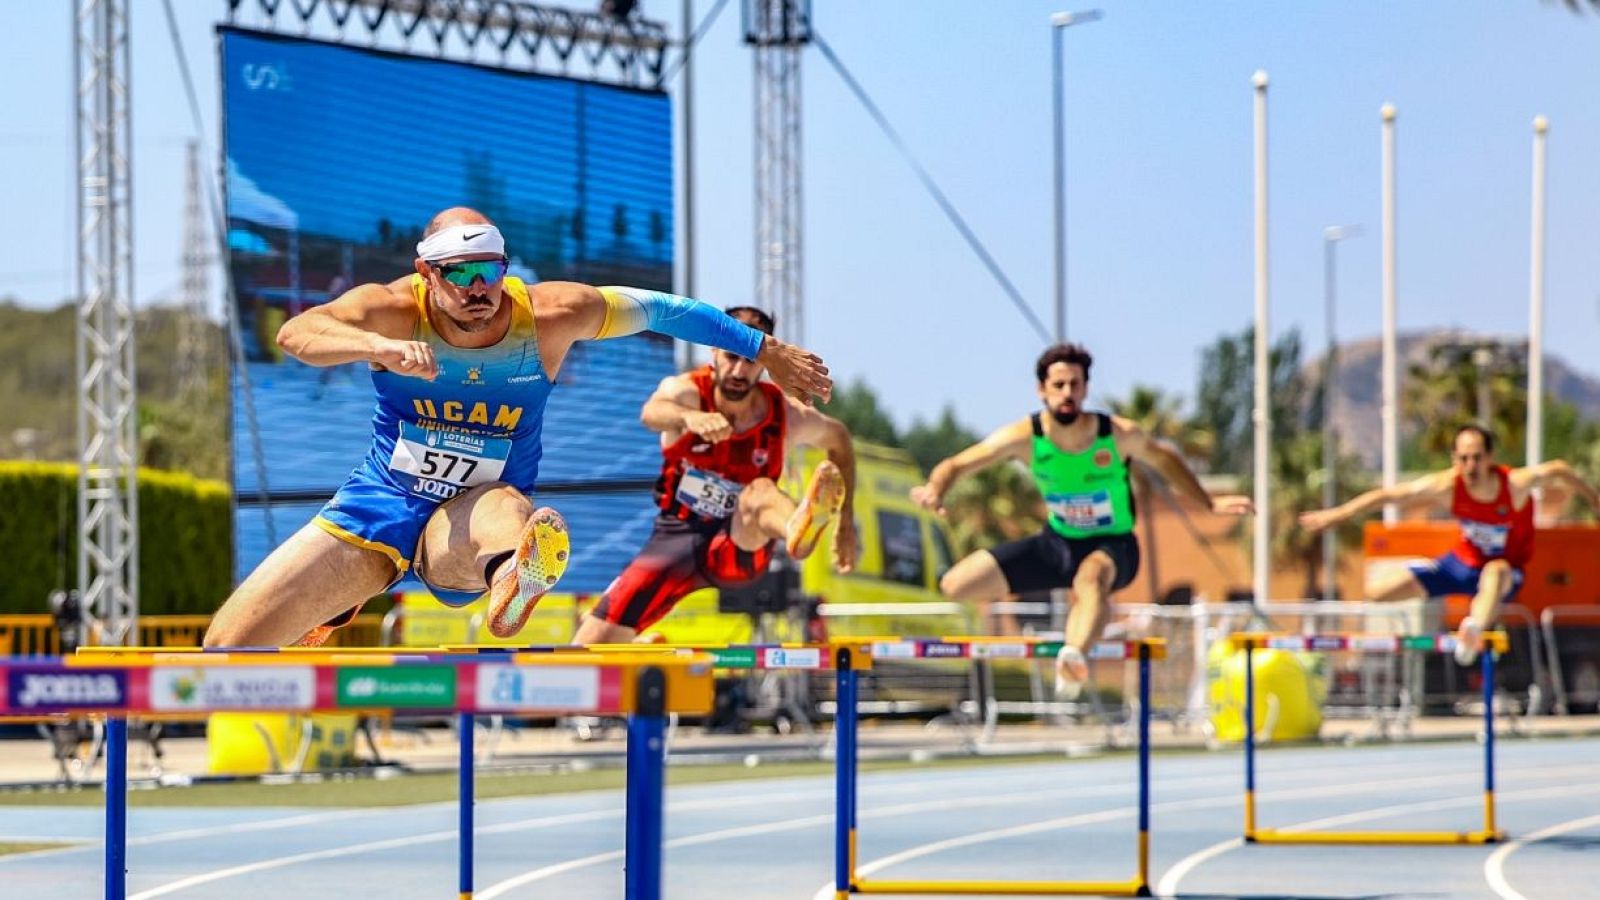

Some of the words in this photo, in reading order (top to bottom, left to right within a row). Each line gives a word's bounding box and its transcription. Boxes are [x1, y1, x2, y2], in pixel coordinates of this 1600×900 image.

[413, 399, 523, 431] UCAM
[420, 451, 478, 482] 577
[701, 484, 736, 509] 538
